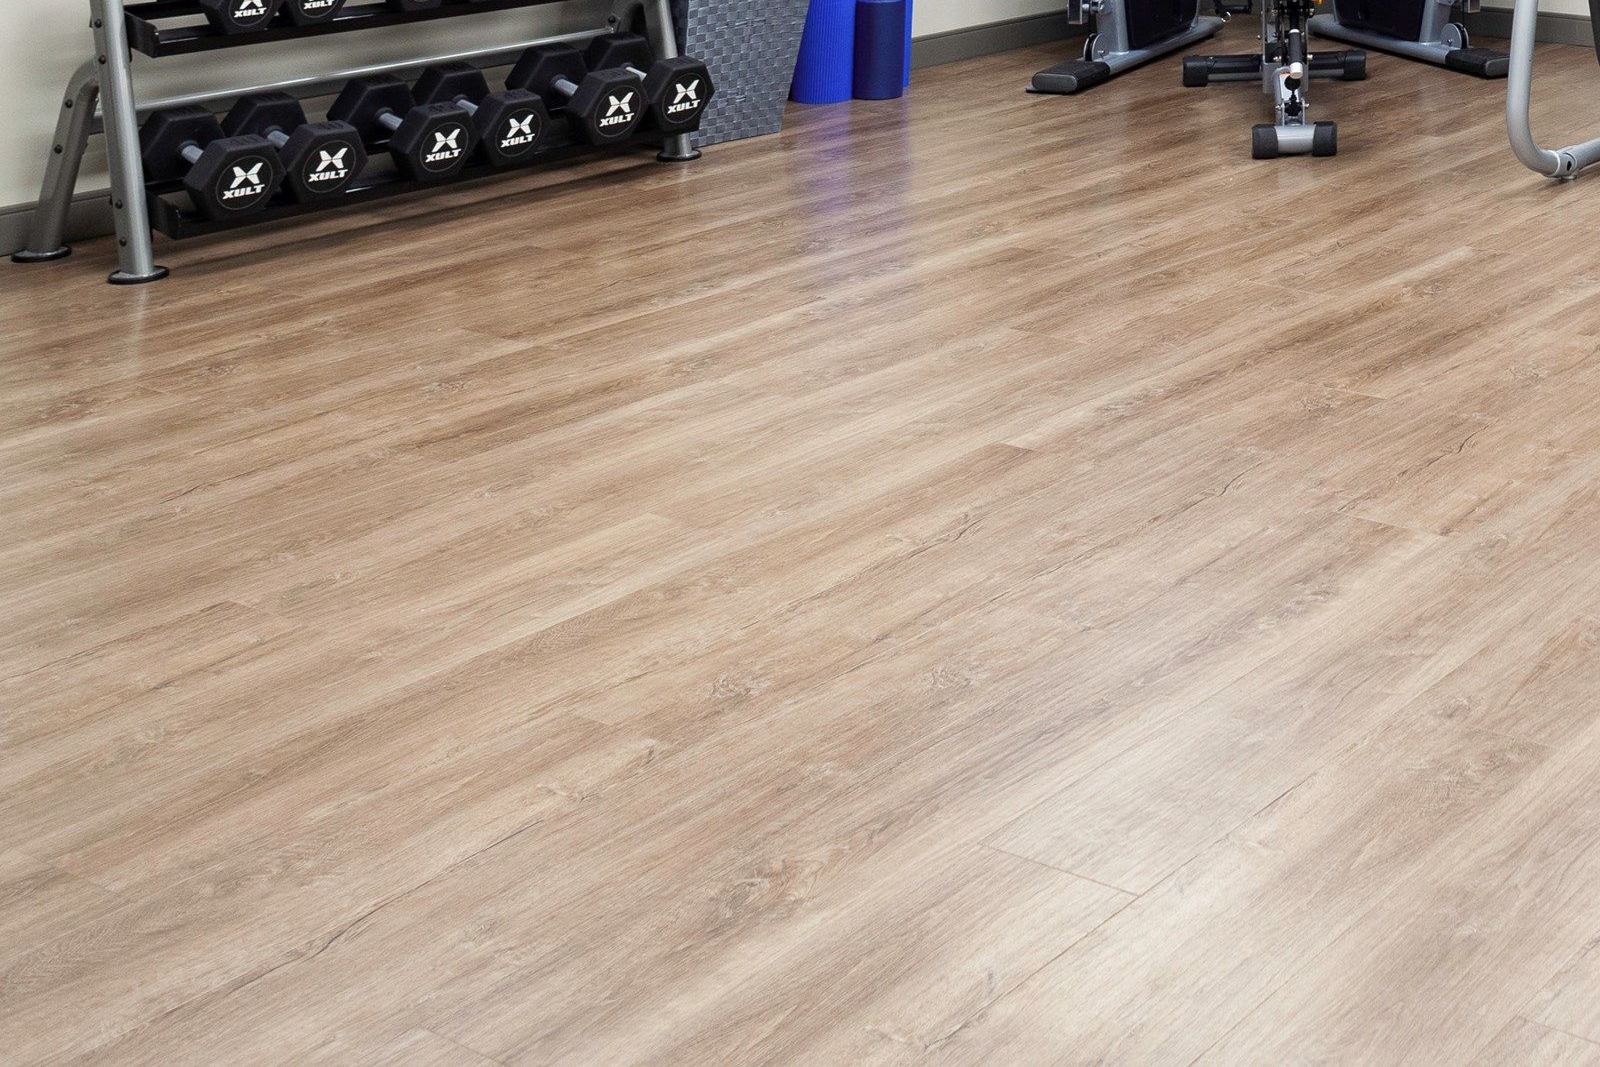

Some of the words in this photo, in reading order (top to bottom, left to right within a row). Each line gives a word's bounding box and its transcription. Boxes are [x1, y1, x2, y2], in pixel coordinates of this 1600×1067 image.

[234, 7, 267, 18] XULT
[667, 99, 701, 115] XULT
[599, 112, 635, 127] XULT
[501, 133, 535, 148] XULT
[425, 148, 461, 163] XULT
[308, 169, 348, 182] XULT
[222, 184, 265, 200] XULT
